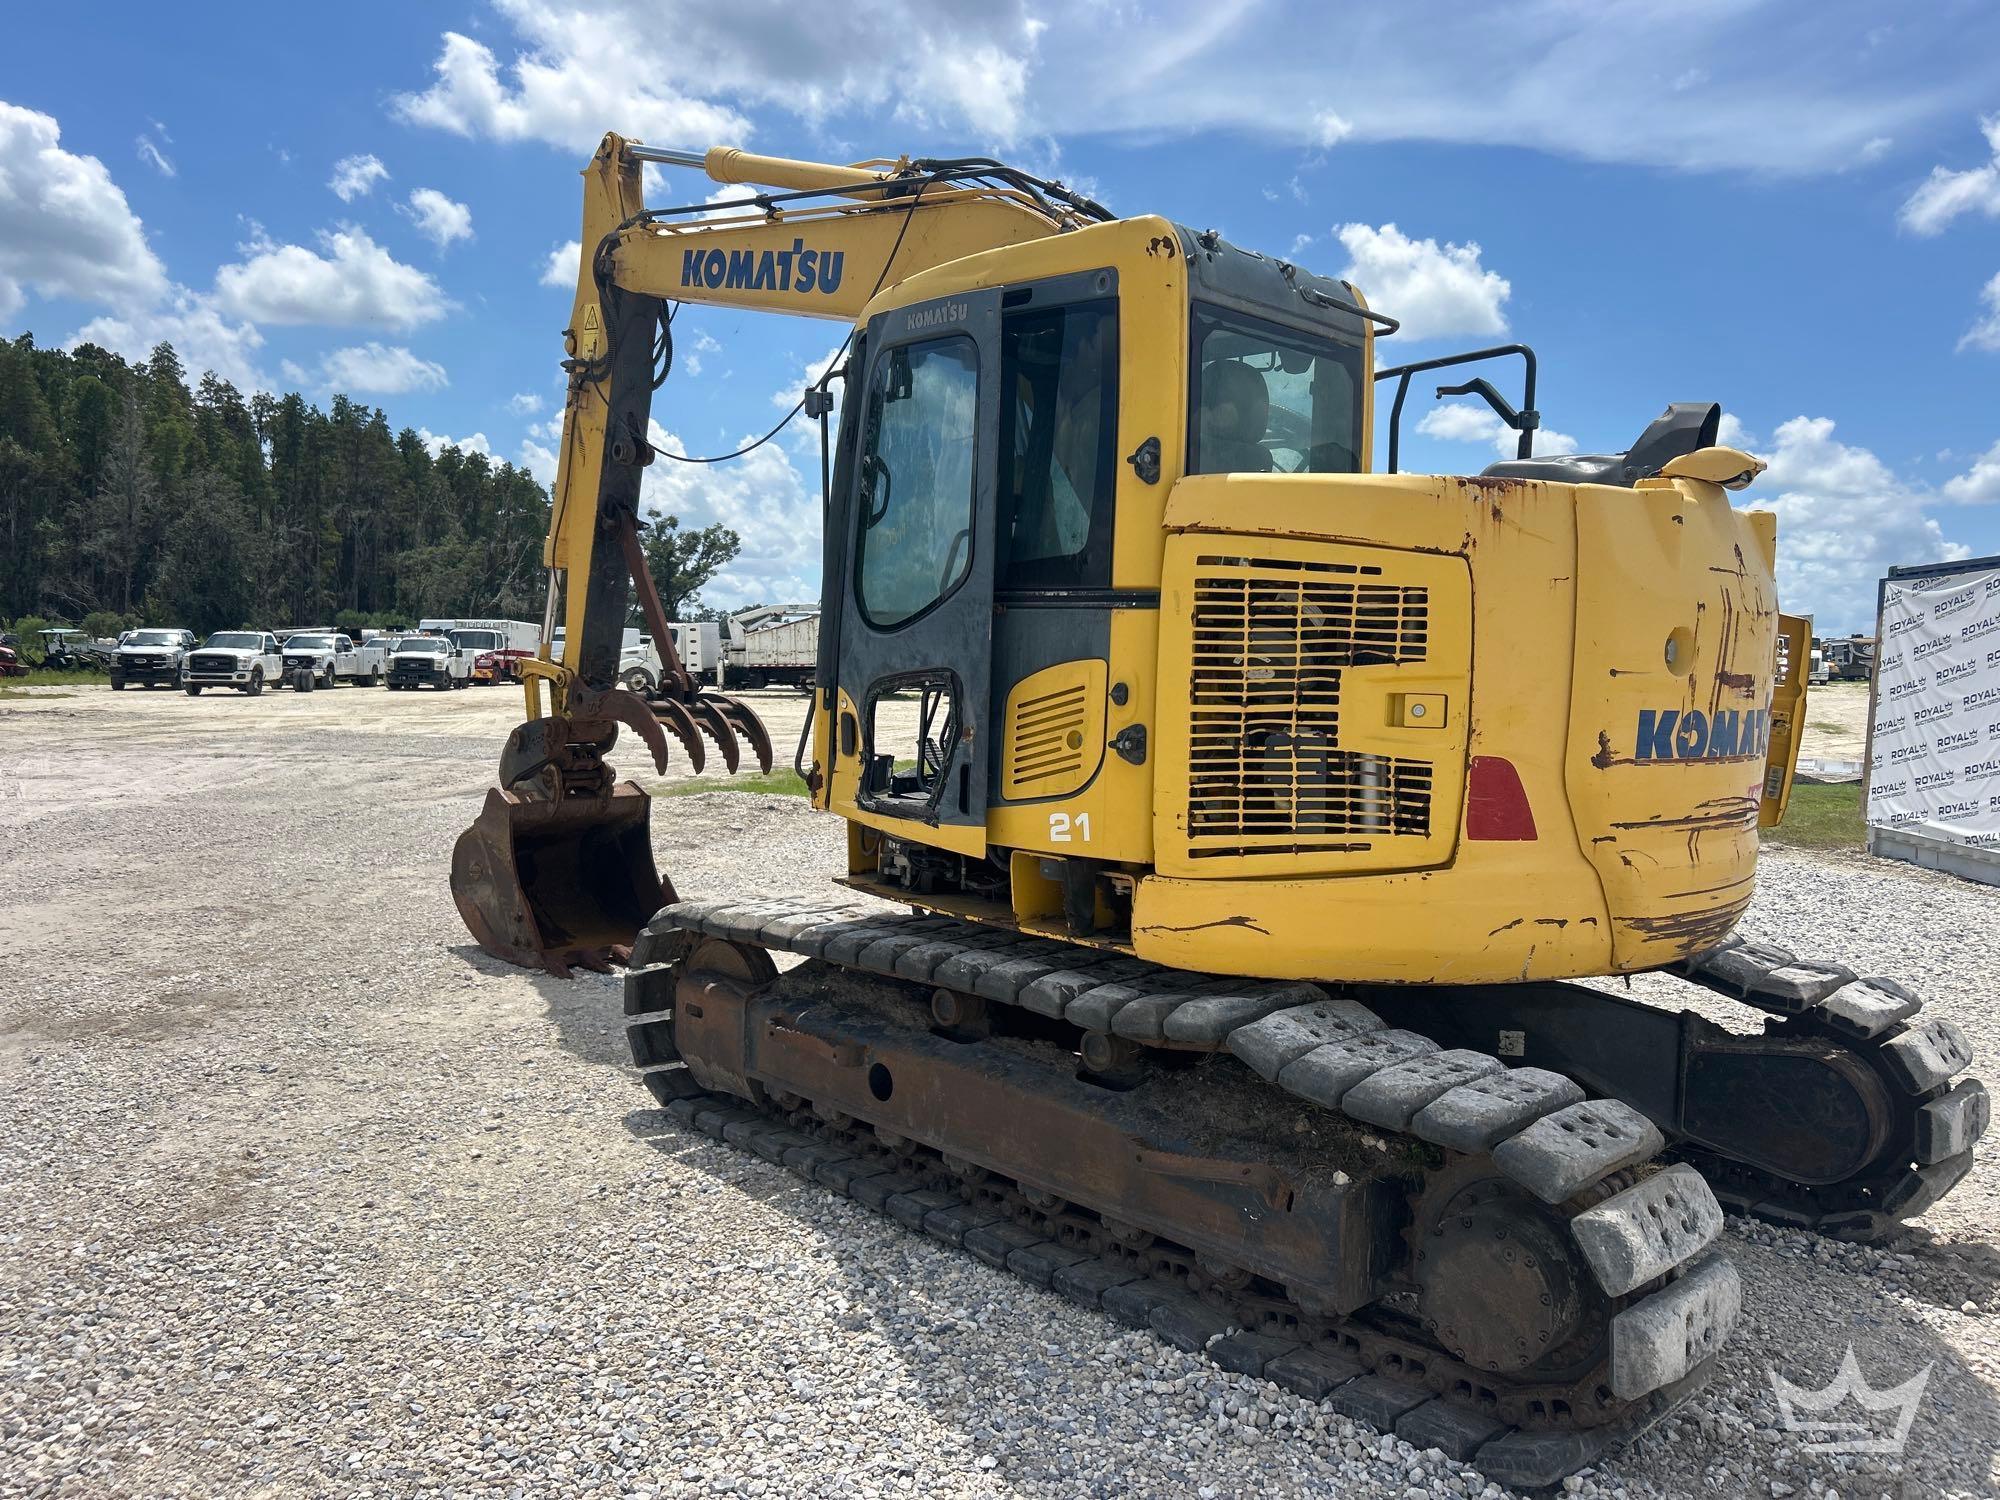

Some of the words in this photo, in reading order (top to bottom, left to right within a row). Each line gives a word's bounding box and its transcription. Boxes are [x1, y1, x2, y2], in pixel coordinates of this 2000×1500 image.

[681, 238, 844, 294] KOMATSU
[907, 300, 968, 331] KOMATSU
[1935, 594, 1966, 614] ROYAL
[1935, 608, 1956, 620] AUCTION
[1957, 600, 1976, 611] GROUP
[1889, 616, 1917, 633] ROYAL
[1961, 617, 1995, 637] ROYAL
[1963, 630, 1985, 643] AUCTION
[1913, 637, 1944, 656] ROYAL
[1914, 649, 1935, 662] AUCTION
[1935, 643, 1952, 654] GROUP
[1936, 662, 1968, 680] ROYAL
[1936, 675, 1958, 687] AUCTION
[1958, 669, 1977, 680] GROUP
[1889, 680, 1918, 696] ROYAL
[1890, 690, 1910, 702] AUCTION
[1910, 687, 1927, 697] GROUP
[1963, 688, 1997, 706] ROYAL
[1914, 705, 1945, 721] ROYAL
[1963, 701, 1987, 713] AUCTION
[1914, 715, 1936, 727] AUCTION
[1935, 711, 1953, 721] GROUP
[1937, 731, 1969, 747] ROYAL
[1937, 744, 1960, 754] AUCTION
[1960, 739, 1979, 749] GROUP
[1891, 745, 1919, 760] ROYAL
[1891, 757, 1911, 766] AUCTION
[1911, 752, 1928, 762] GROUP
[1964, 760, 1998, 776] ROYAL
[1915, 772, 1946, 787] ROYAL
[1965, 773, 1988, 782] AUCTION
[1871, 782, 1899, 796] ROYAL
[1916, 783, 1937, 793] AUCTION
[1937, 780, 1955, 789] GROUP
[1872, 794, 1890, 802] AUCTION
[1890, 790, 1907, 798] GROUP
[1938, 801, 1970, 815] ROYAL
[1939, 813, 1961, 822] AUCTION
[1961, 810, 1979, 819] GROUP
[1890, 811, 1920, 824] ROYAL
[1049, 812, 1091, 842] 21
[1964, 833, 1997, 845] ROYAL
